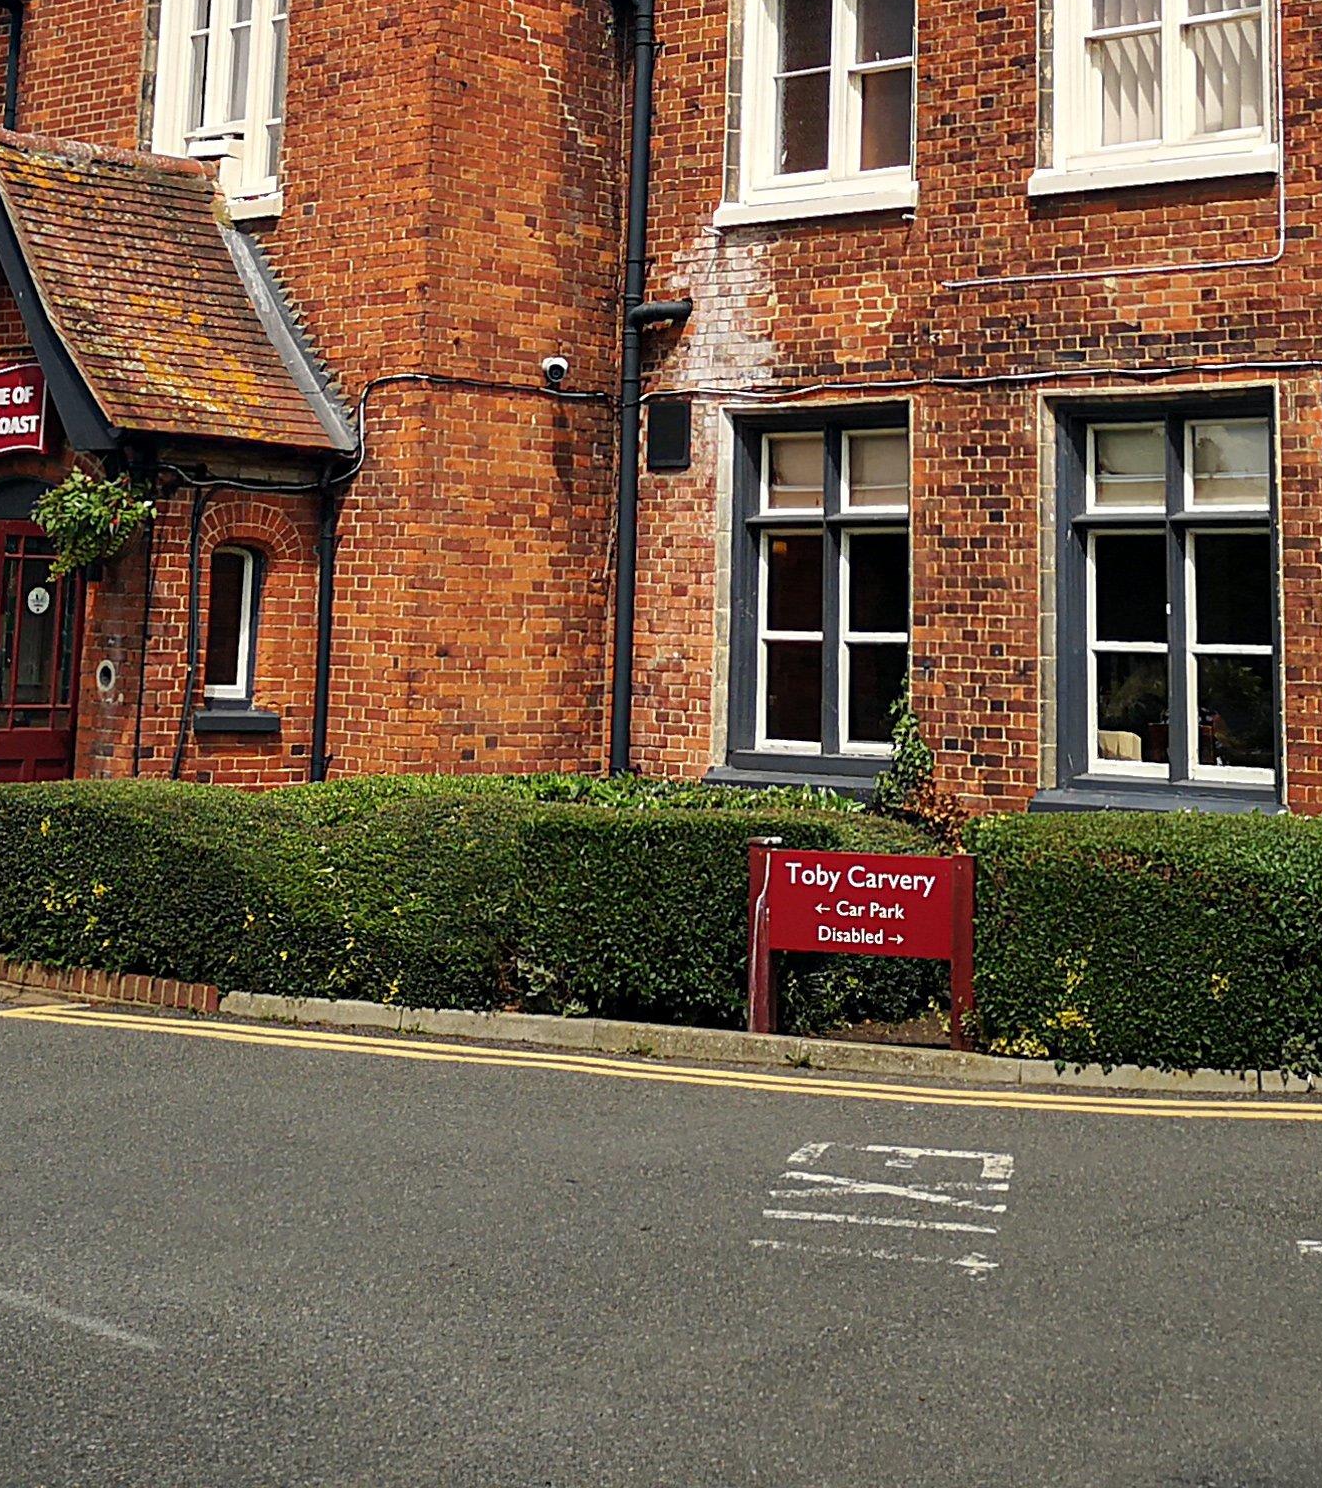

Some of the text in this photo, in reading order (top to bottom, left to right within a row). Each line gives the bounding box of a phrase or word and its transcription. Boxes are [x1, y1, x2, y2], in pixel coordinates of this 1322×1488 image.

[12, 386, 34, 405] OF
[785, 862, 937, 898] Toby Carvery
[836, 900, 906, 920] Car Park
[818, 925, 885, 945] Disabled
